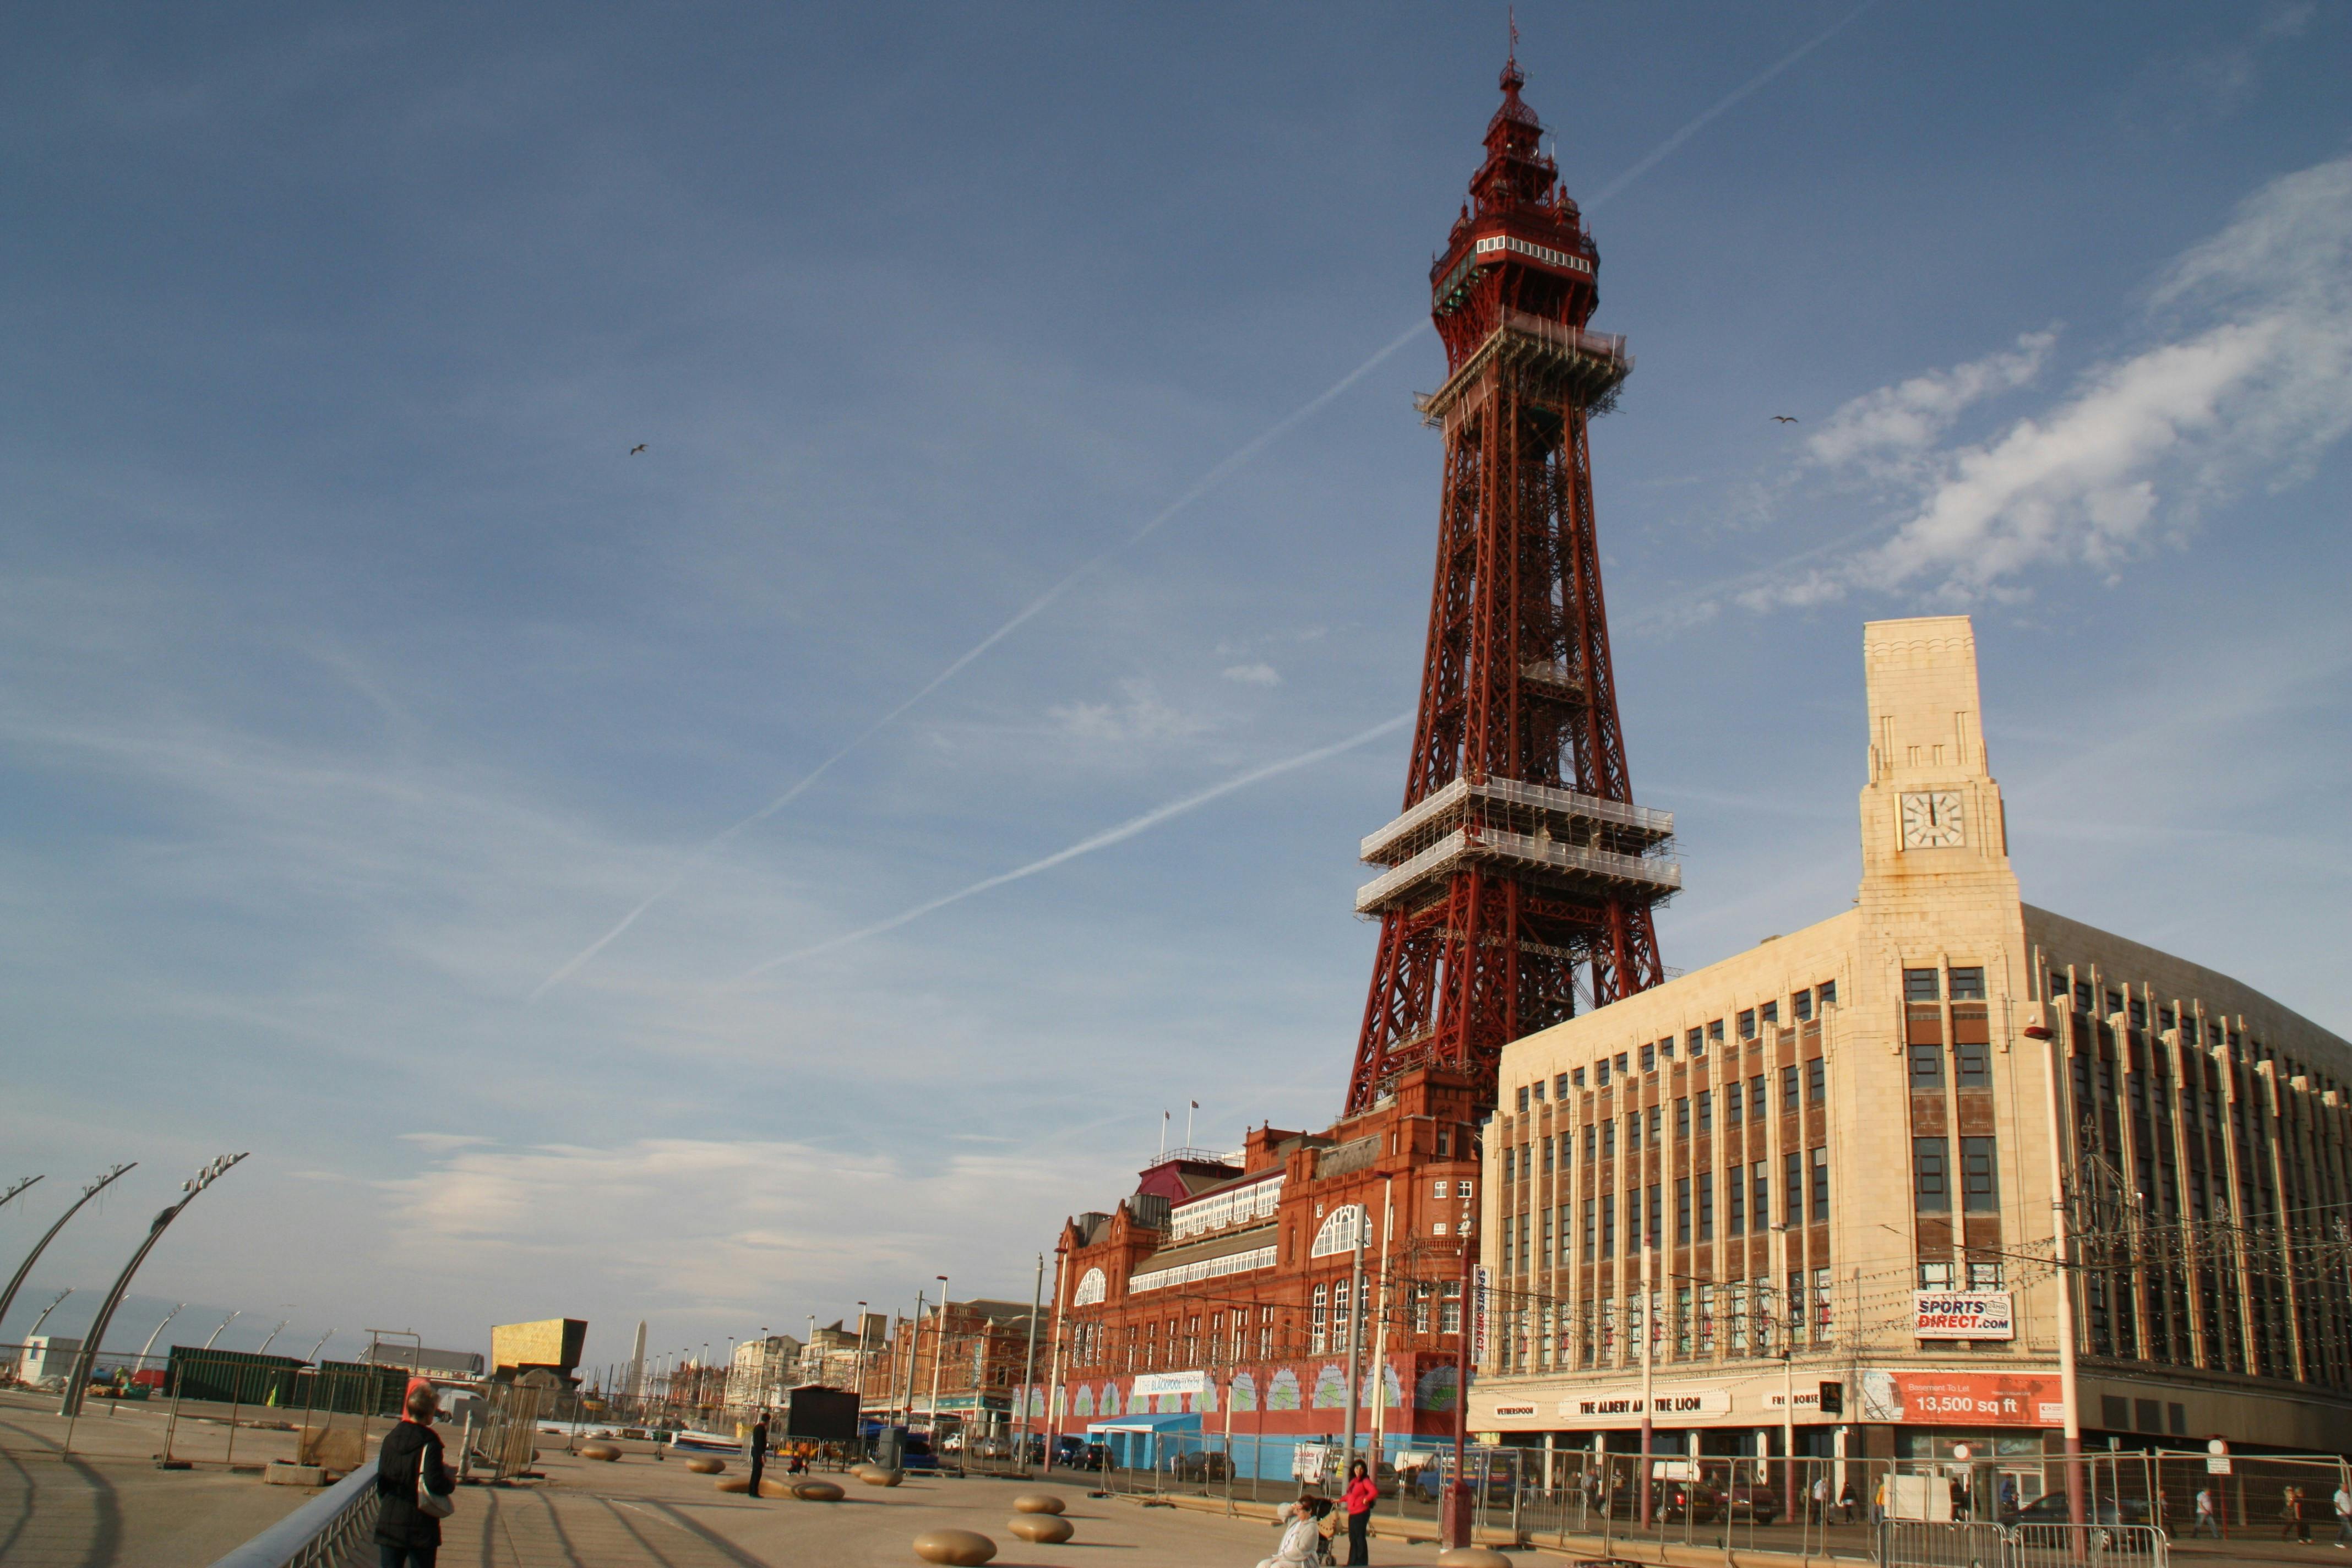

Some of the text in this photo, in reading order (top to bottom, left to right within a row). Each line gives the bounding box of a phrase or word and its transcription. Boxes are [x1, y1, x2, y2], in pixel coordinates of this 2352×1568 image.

[1918, 1300, 1985, 1314] SPORTS
[1580, 1397, 1701, 1414] THE ALBERT AN THE LION
[1772, 1396, 1785, 1405] FRE
[1793, 1394, 1819, 1404] HOUSE
[1917, 1397, 2017, 1415] 13,500 sq ft
